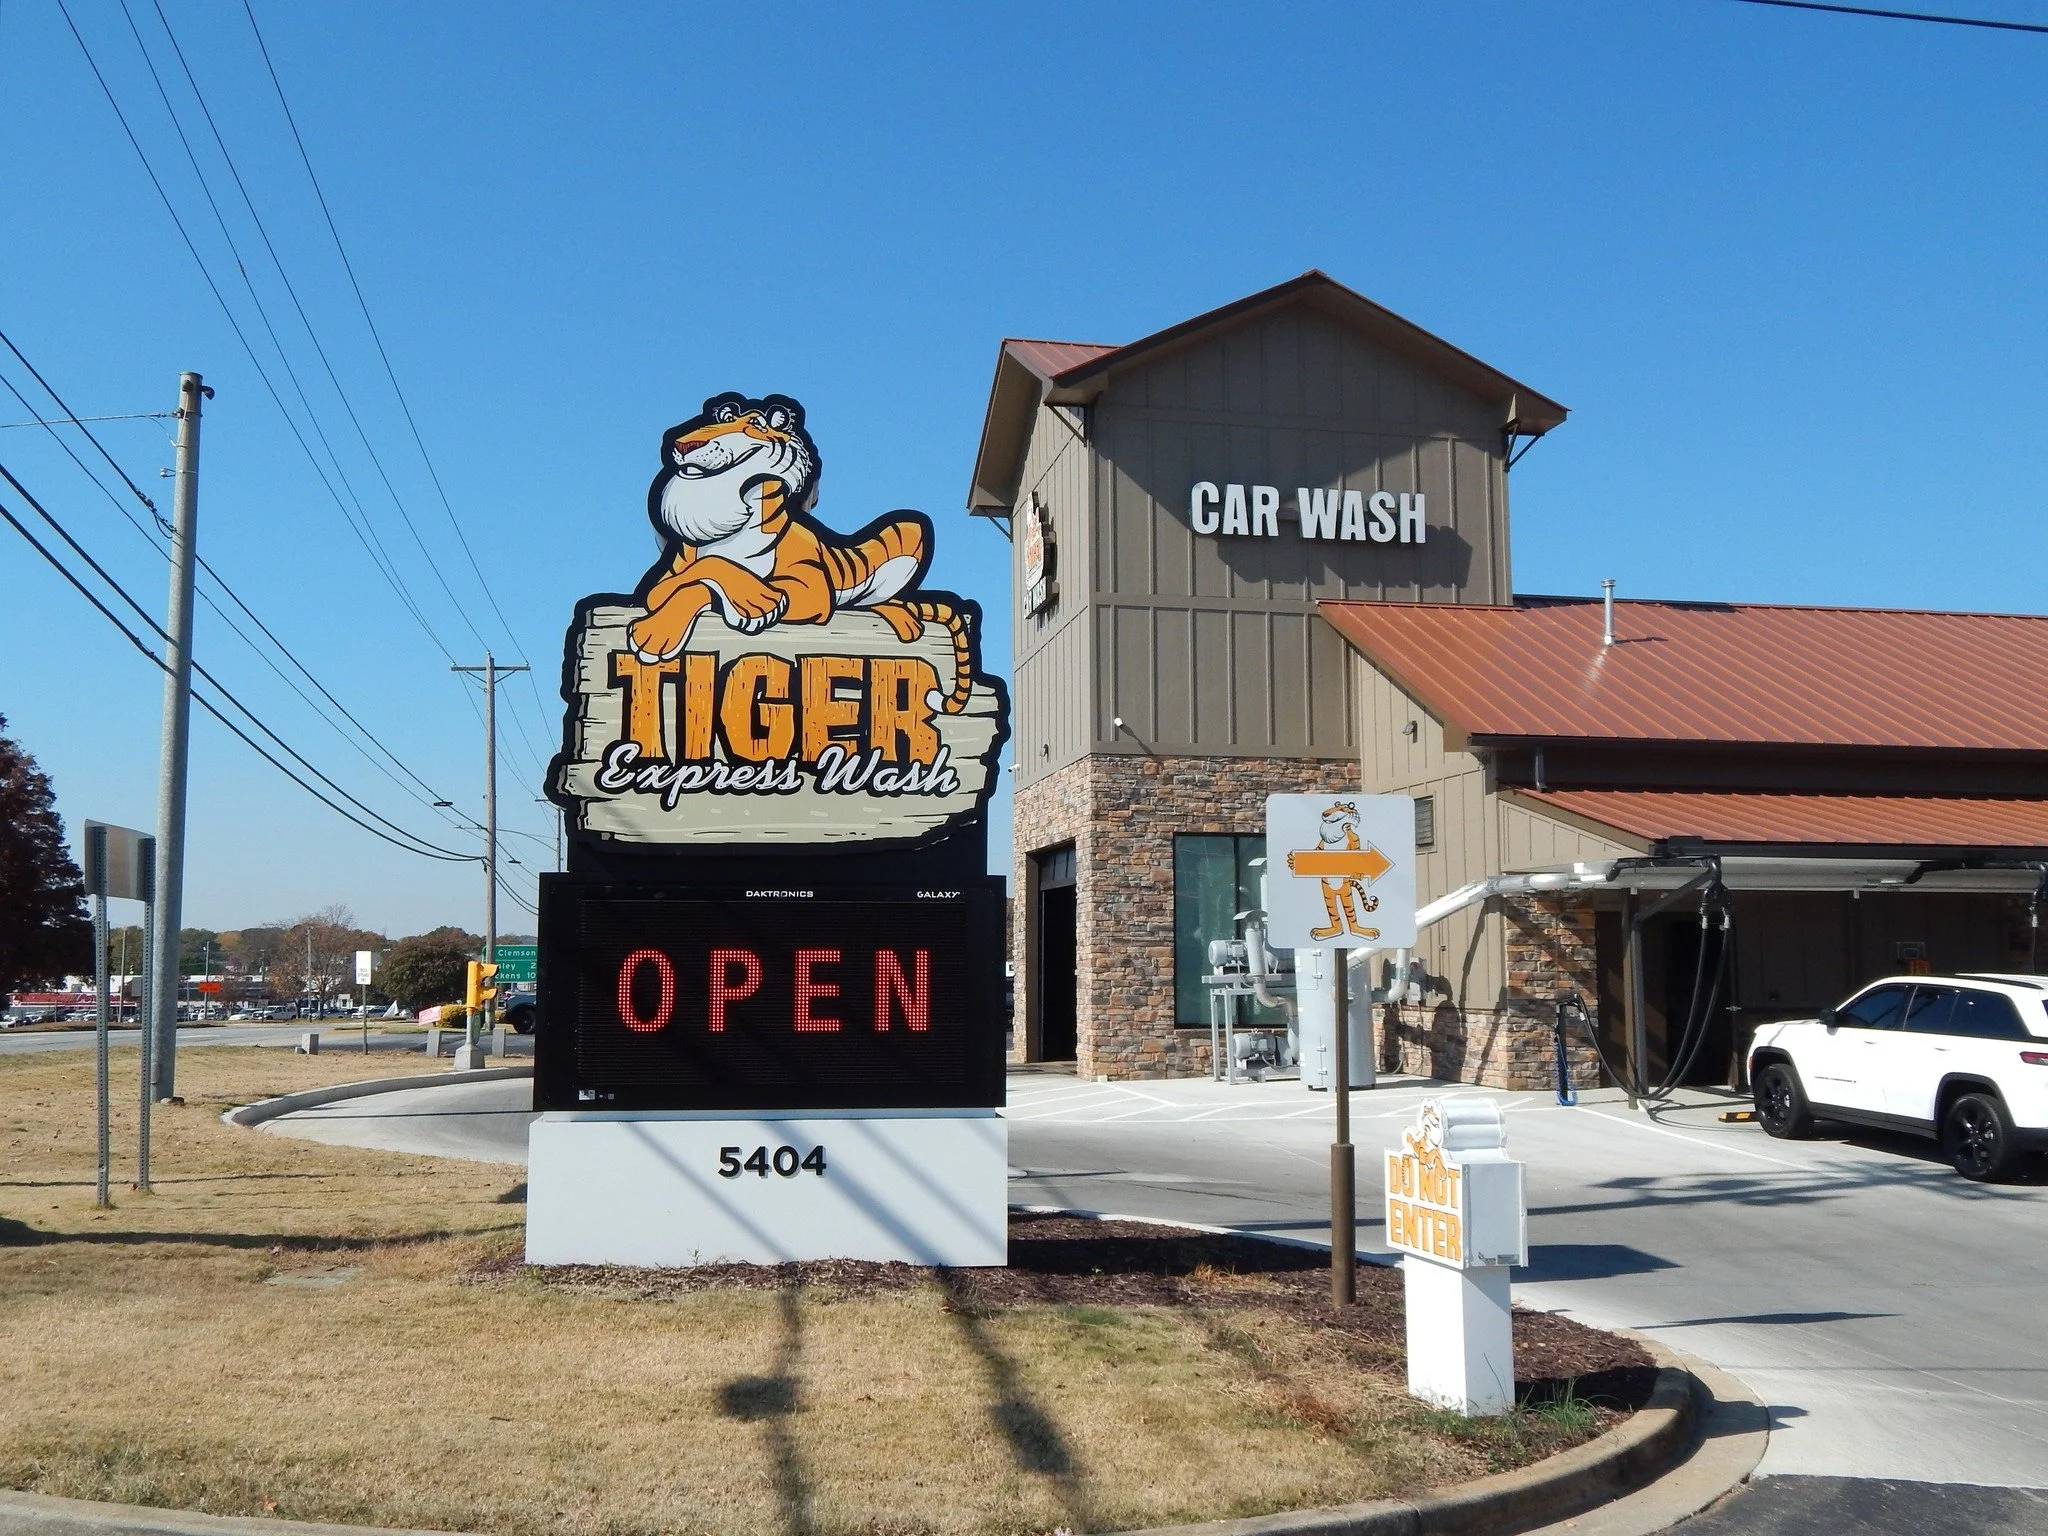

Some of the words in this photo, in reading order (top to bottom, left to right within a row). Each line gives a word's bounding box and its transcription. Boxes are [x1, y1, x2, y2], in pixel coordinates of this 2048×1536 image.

[1191, 481, 1279, 537] CAR
[1298, 487, 1427, 544] WASH
[611, 651, 943, 767] TIGER
[600, 743, 802, 807] Express
[817, 745, 958, 792] Wash
[745, 890, 814, 898] DAKTRONICS
[916, 890, 961, 899] GALAXY
[497, 949, 536, 957] Clemson
[526, 971, 537, 979] 10
[618, 949, 930, 1032] OPEN
[717, 1145, 827, 1178] 5404
[1389, 1154, 1415, 1198] DO
[1419, 1158, 1461, 1209] NOT
[1389, 1198, 1461, 1262] ENTER
